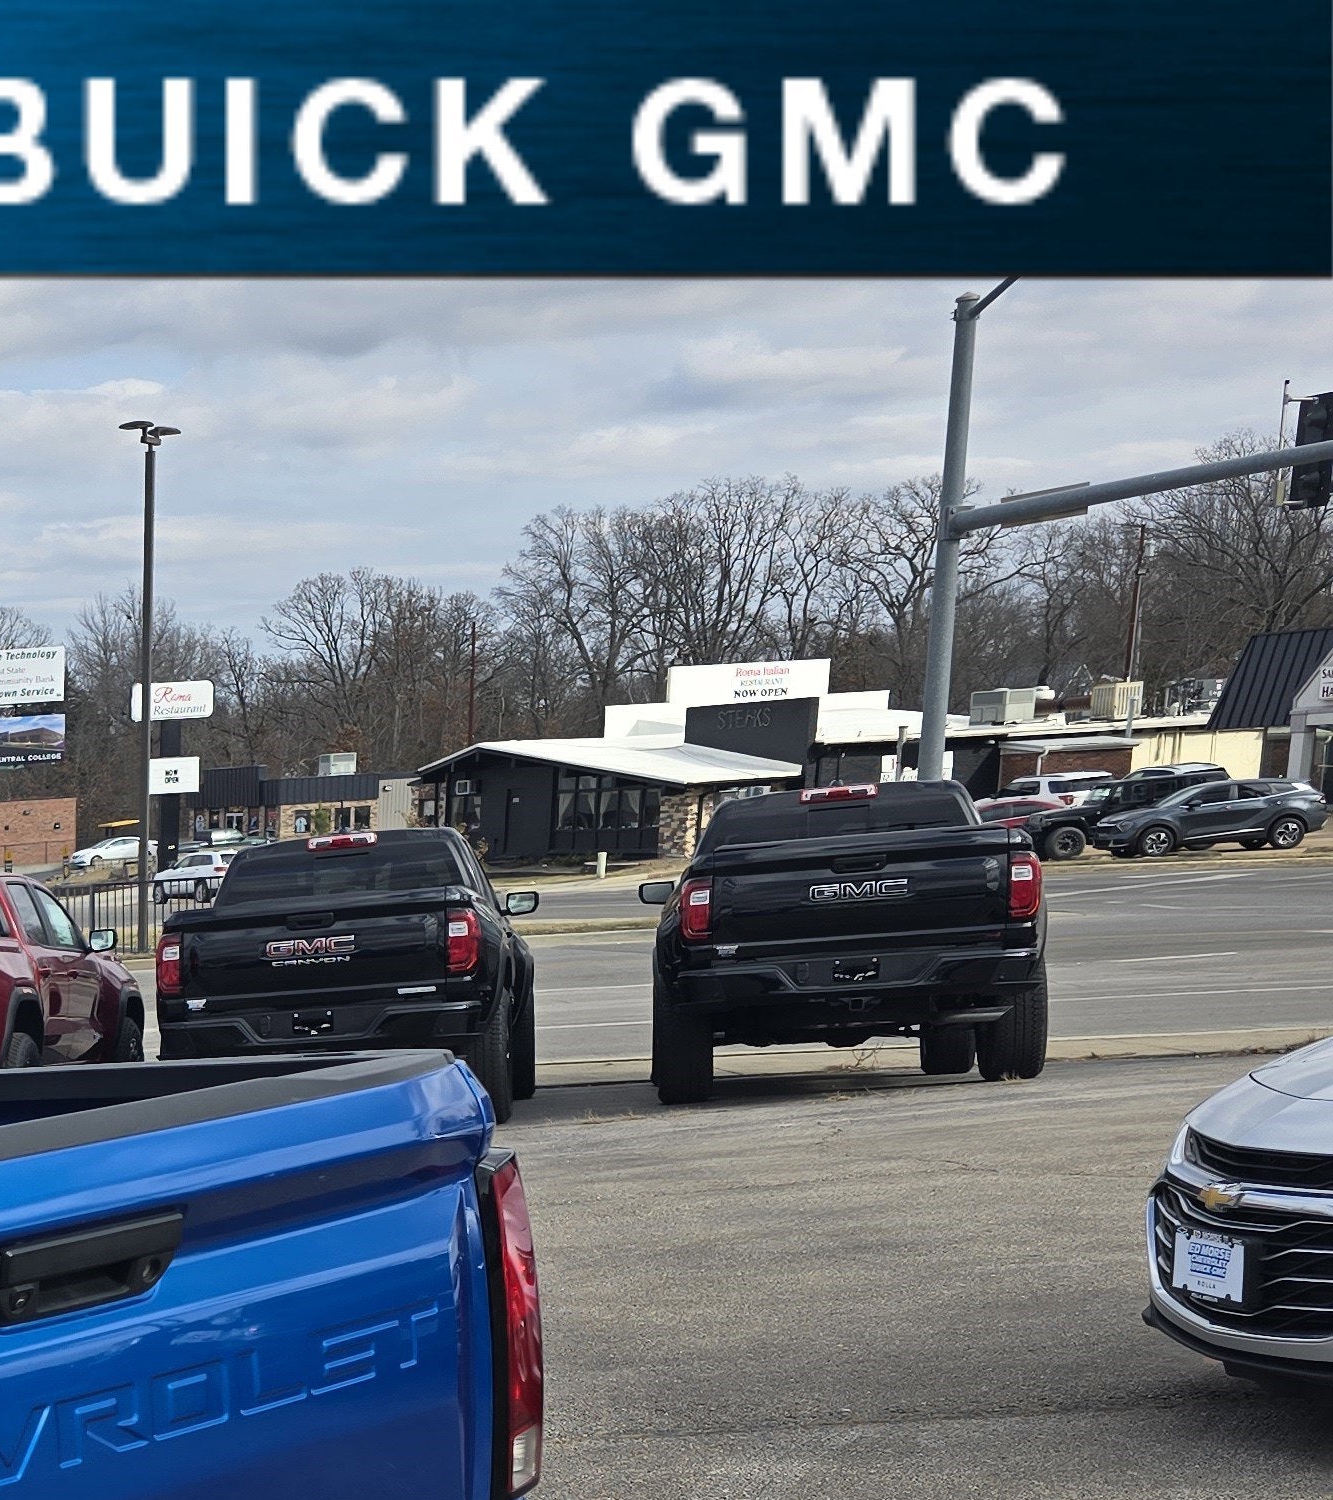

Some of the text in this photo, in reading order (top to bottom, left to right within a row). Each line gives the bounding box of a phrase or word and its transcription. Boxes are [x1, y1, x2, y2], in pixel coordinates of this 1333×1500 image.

[5, 649, 58, 661] Technology
[735, 667, 761, 677] Roma
[35, 675, 55, 683] Bank
[19, 687, 56, 698] Service
[734, 687, 789, 699] NOW OPEN
[153, 704, 207, 716] Restaurant
[27, 752, 62, 762] COLLEGE
[809, 878, 908, 902] GMC
[266, 934, 356, 958] GMC
[271, 955, 351, 968] CANYON
[1189, 1243, 1231, 1261] ED MORSE
